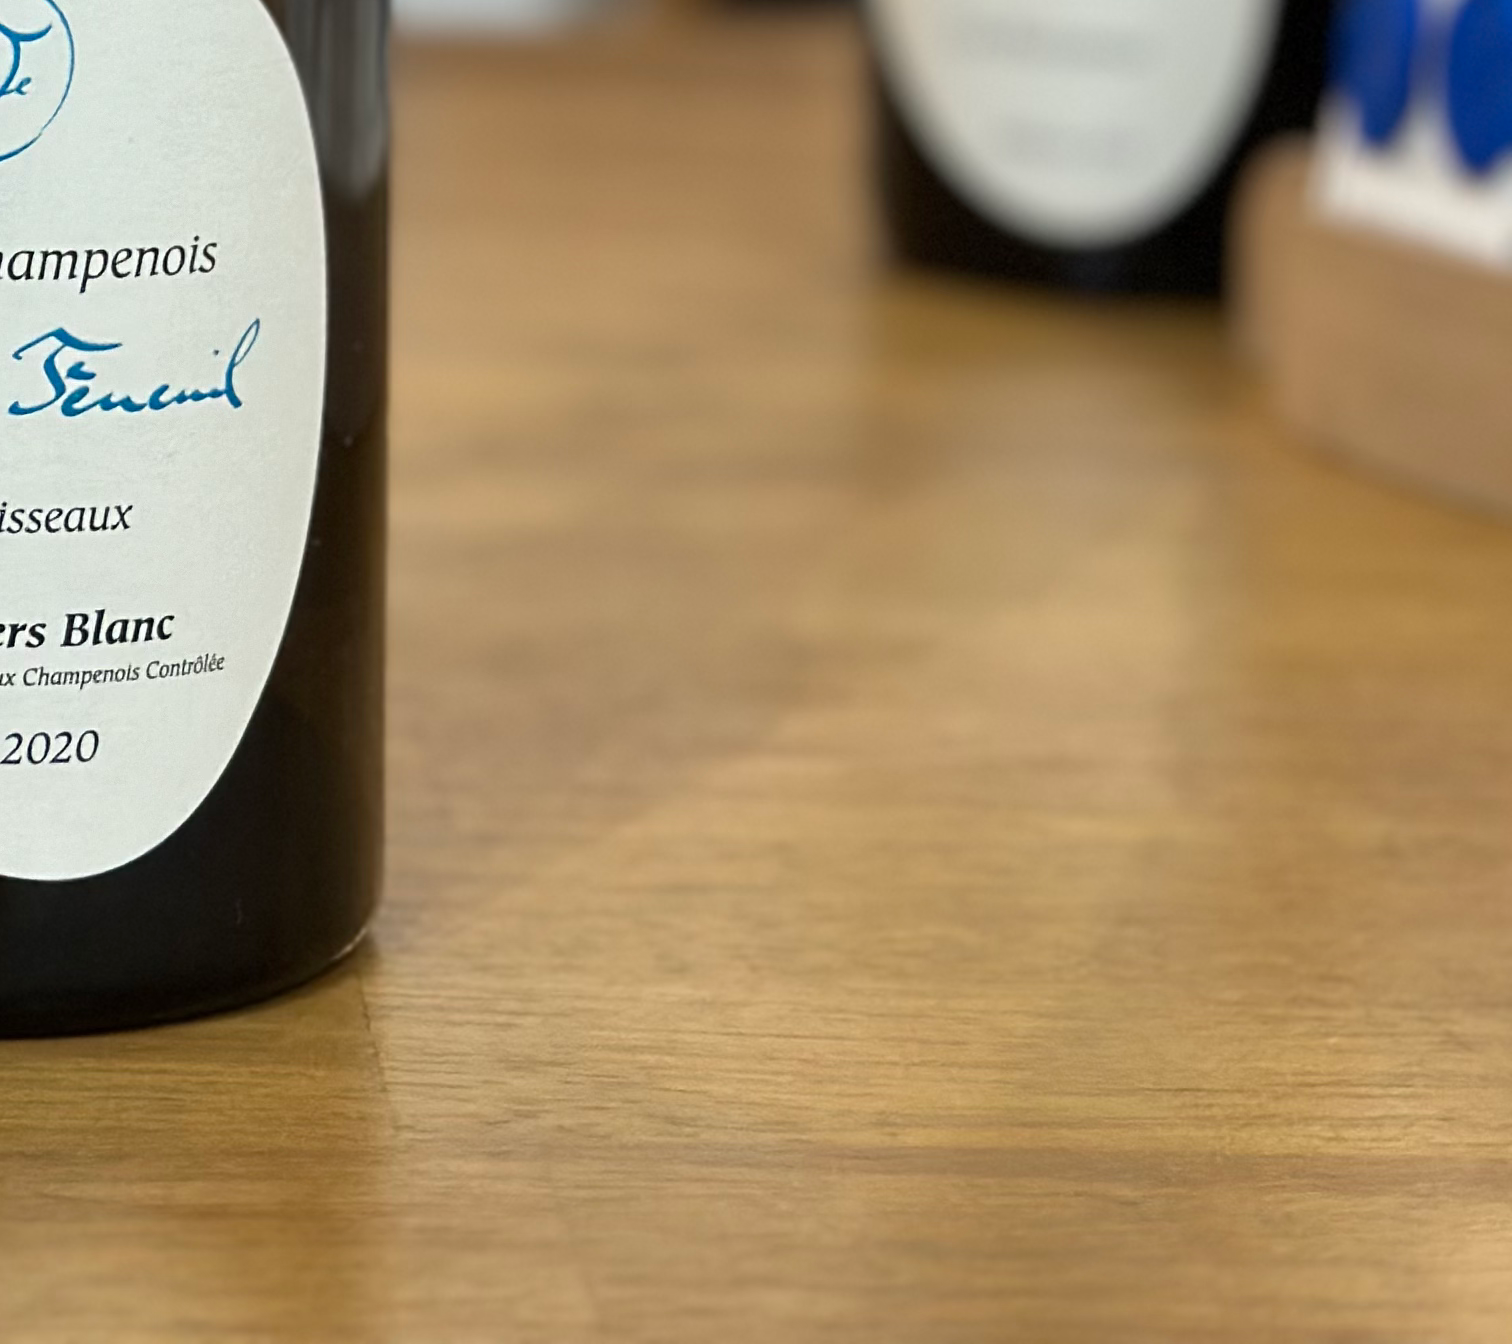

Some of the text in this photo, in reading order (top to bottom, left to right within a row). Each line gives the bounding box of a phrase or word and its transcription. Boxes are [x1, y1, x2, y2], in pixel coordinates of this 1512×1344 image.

[59, 607, 177, 649] Blanc
[21, 664, 142, 691] Champenois
[145, 651, 227, 681] Contrôlée
